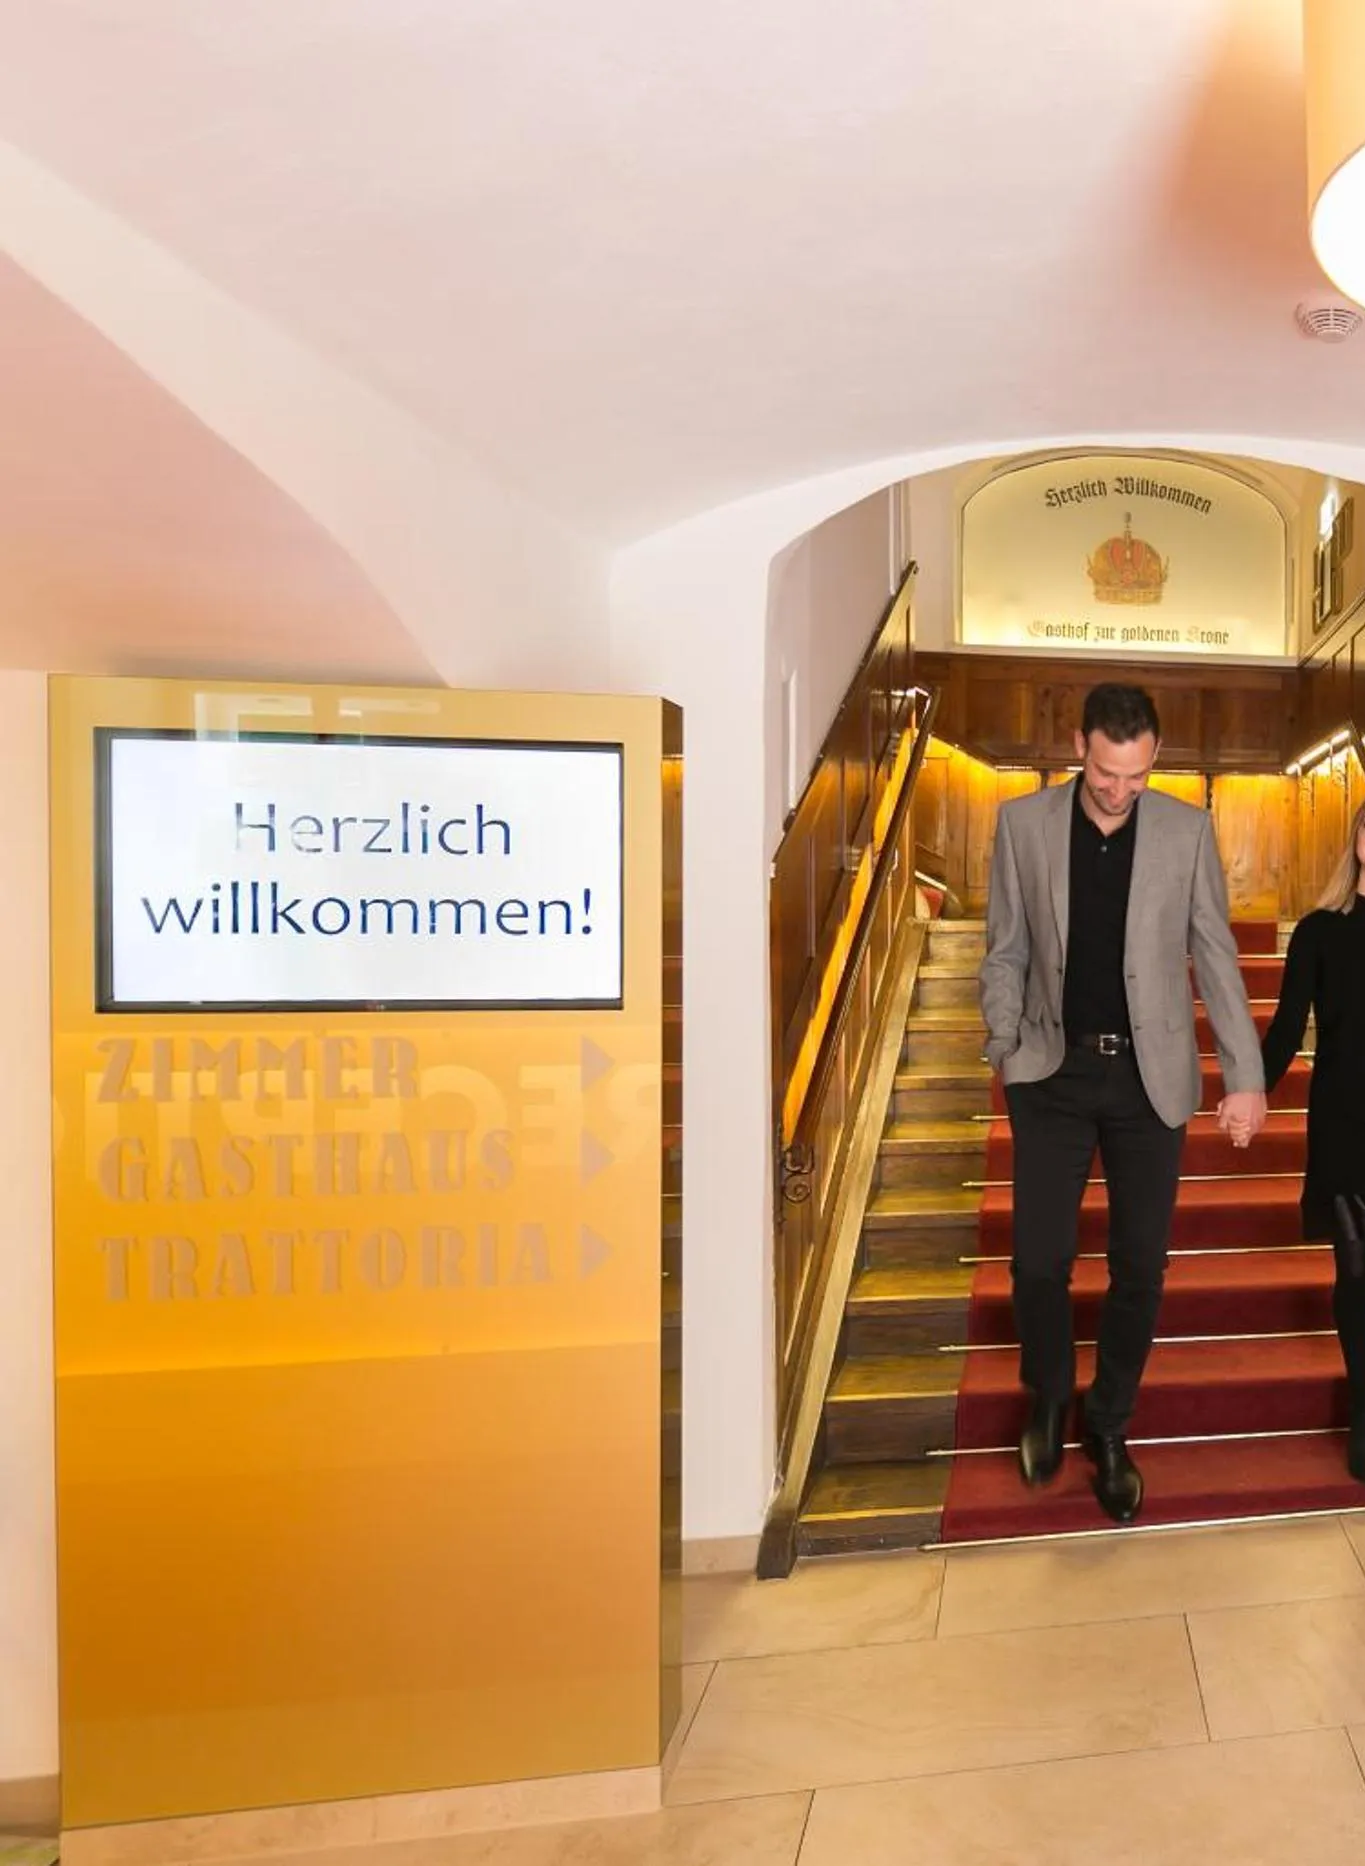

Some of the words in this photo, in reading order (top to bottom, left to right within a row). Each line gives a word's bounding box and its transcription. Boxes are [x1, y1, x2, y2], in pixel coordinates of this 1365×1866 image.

[1044, 479, 1107, 508] Herzlich
[1114, 476, 1212, 514] Willkommen
[1094, 625, 1116, 642] zur
[1121, 625, 1180, 643] goldenen
[233, 801, 512, 856] Herzlich
[140, 881, 593, 936] willkommen!
[97, 1034, 420, 1102] ZIMMER
[100, 1128, 517, 1203] GASTHAUS
[102, 1222, 552, 1303] TRATTORIA
